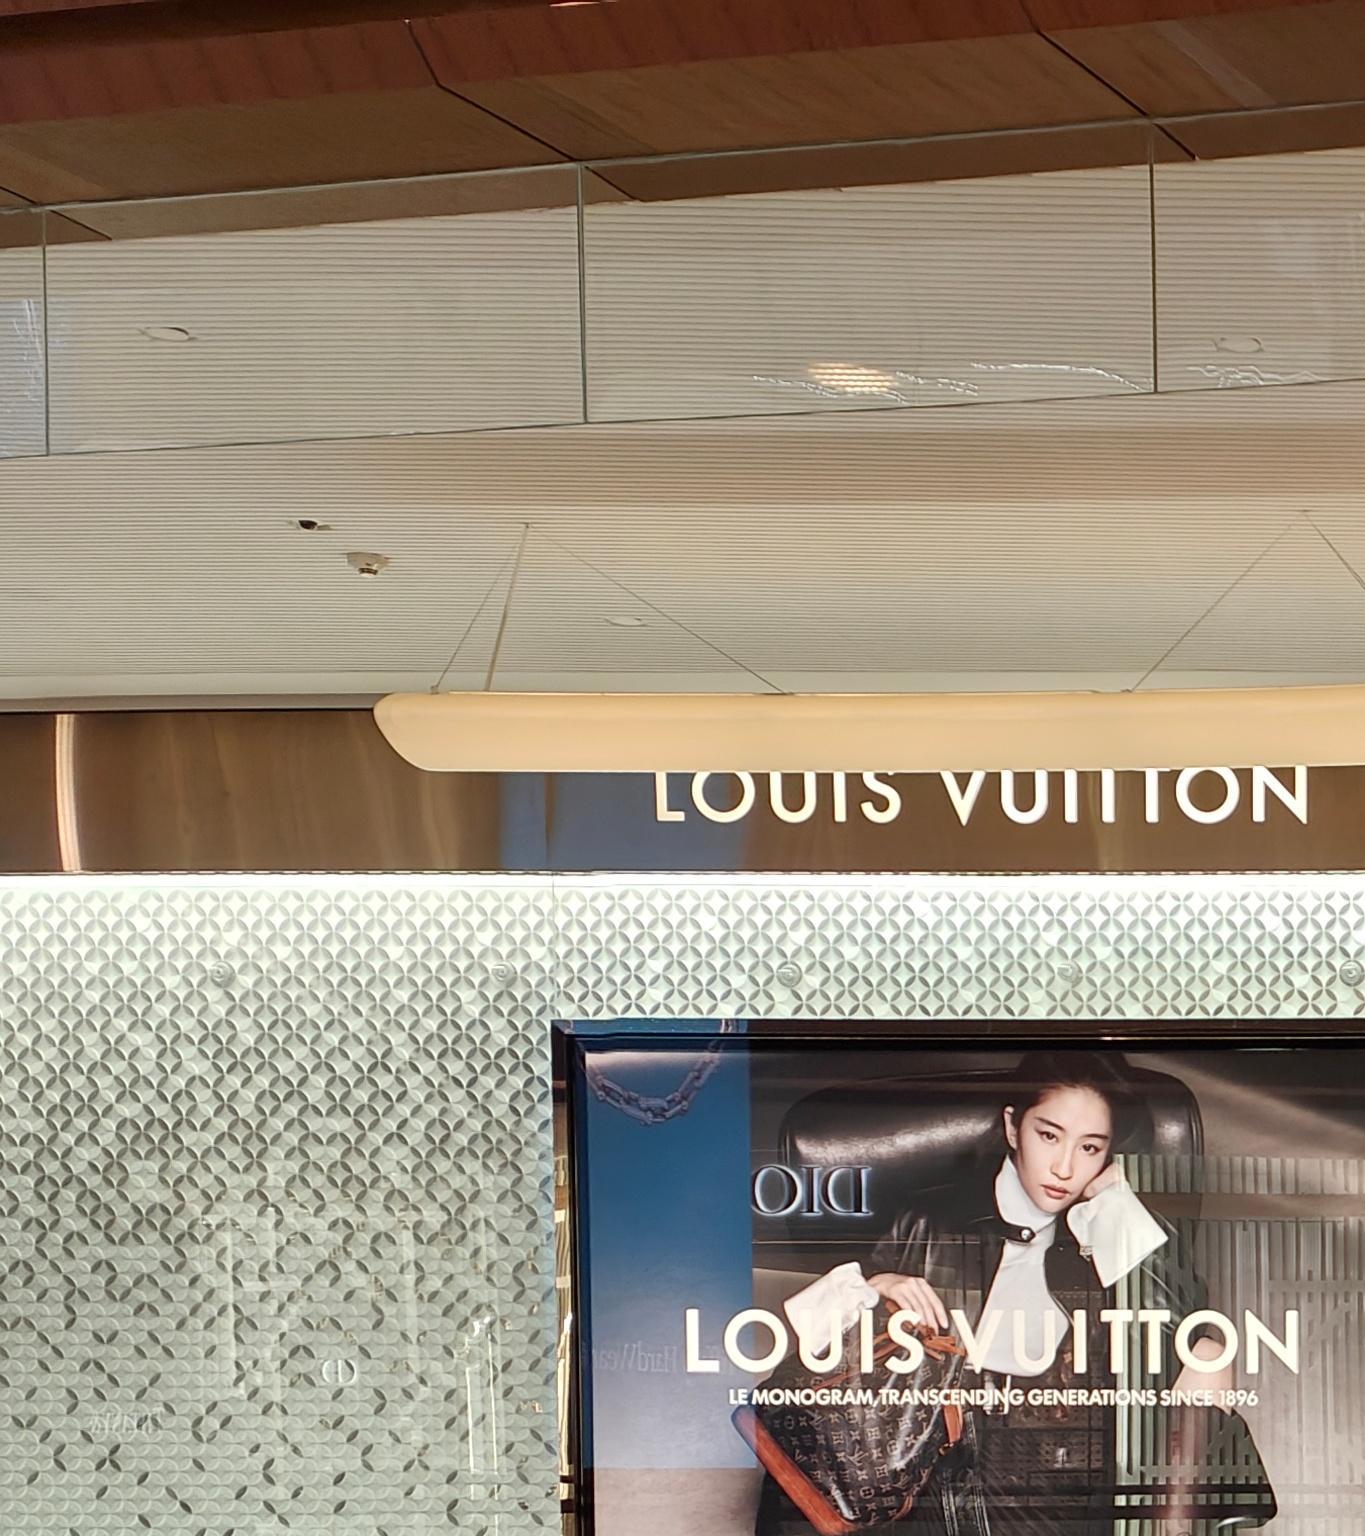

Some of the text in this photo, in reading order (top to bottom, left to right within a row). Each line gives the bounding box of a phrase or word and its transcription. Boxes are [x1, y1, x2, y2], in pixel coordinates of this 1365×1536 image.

[655, 770, 902, 824] LOUIS
[684, 1308, 1299, 1376] LOUIS VUITTON
[728, 1388, 749, 1405] LE
[1027, 1389, 1157, 1406] GENERATIONS
[1159, 1389, 1213, 1406] SINCE
[1220, 1389, 1258, 1406] 1896
